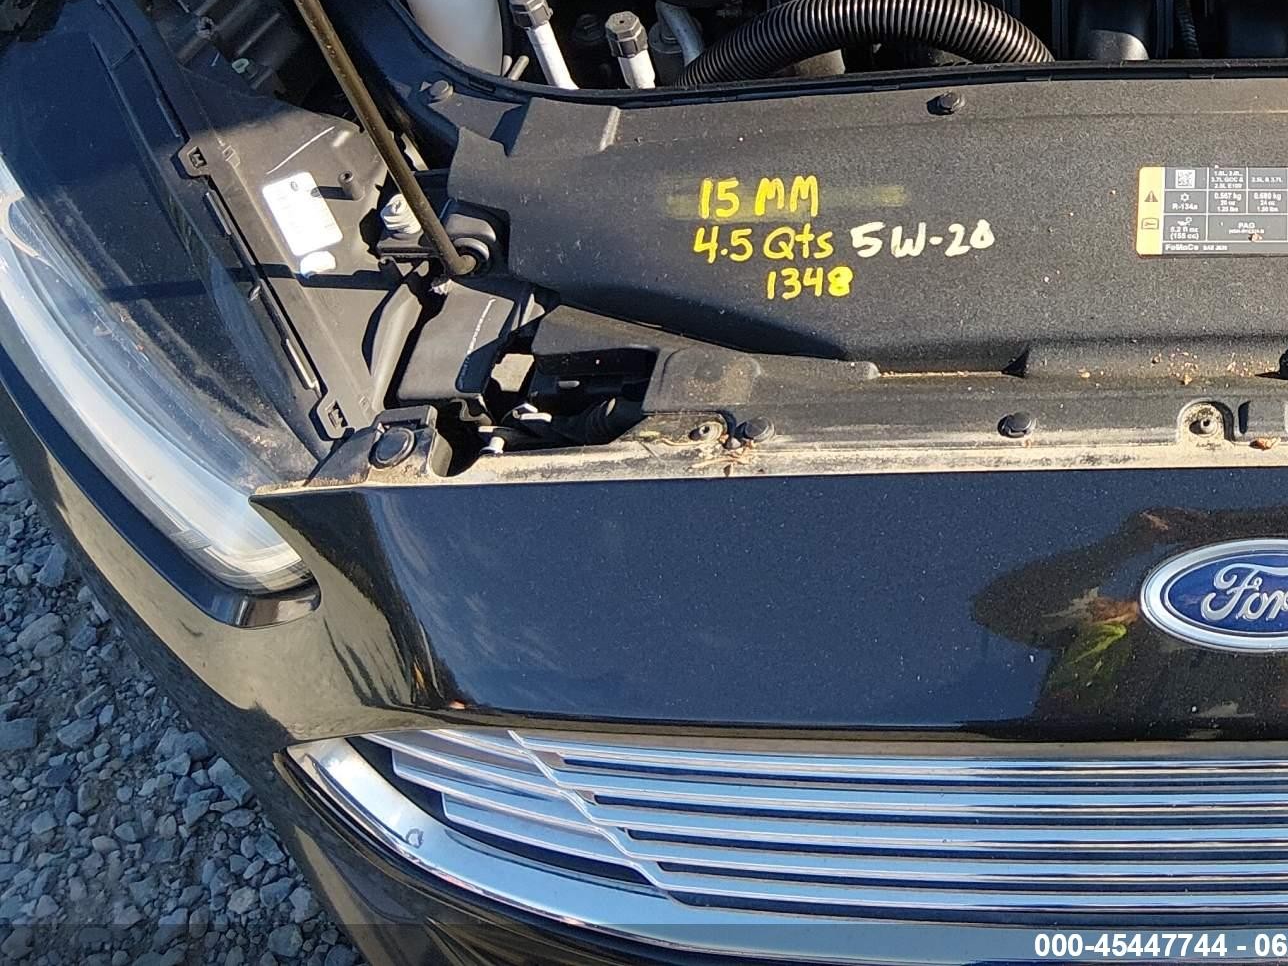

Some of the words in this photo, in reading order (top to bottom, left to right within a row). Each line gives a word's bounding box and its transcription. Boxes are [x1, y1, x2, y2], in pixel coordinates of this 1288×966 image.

[700, 177, 740, 219] 15
[754, 175, 819, 217] MM
[693, 225, 753, 264] 4.5
[763, 223, 834, 260] Qts
[766, 265, 853, 300] 1348
